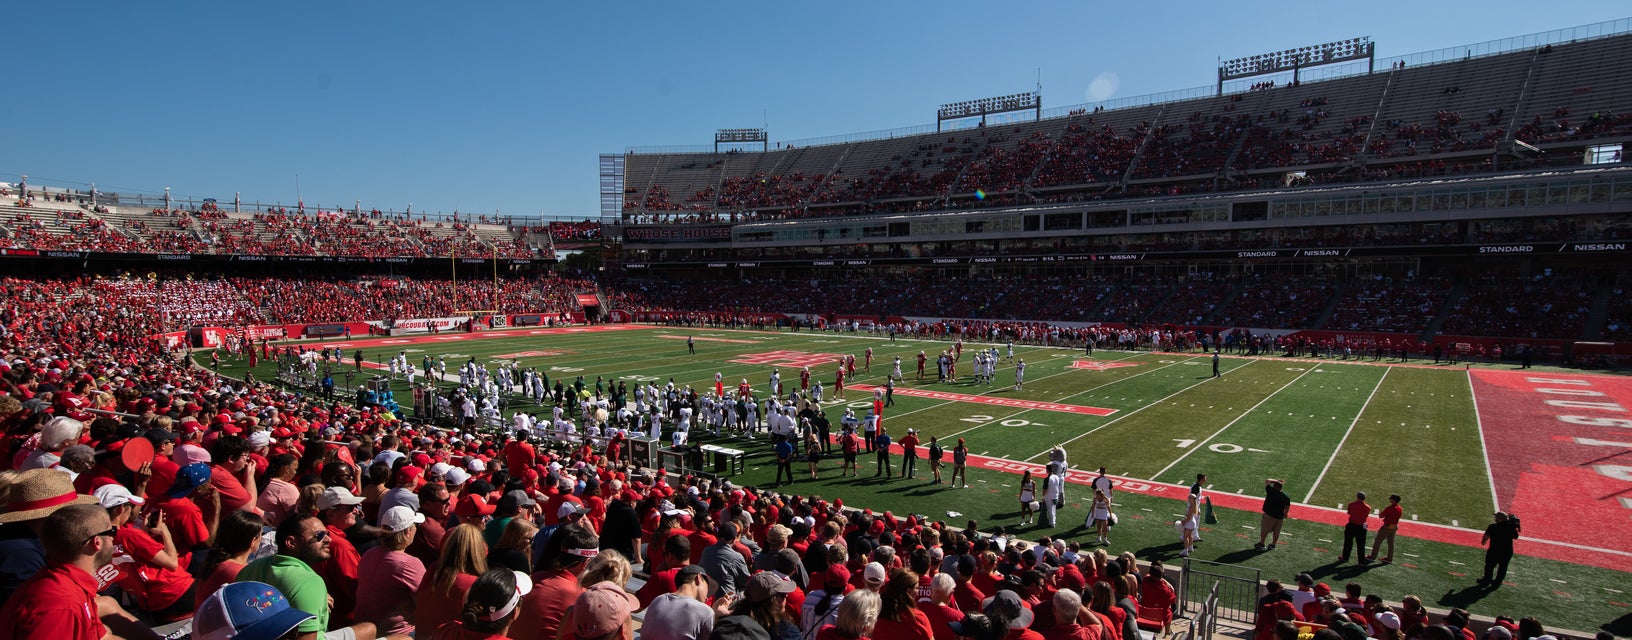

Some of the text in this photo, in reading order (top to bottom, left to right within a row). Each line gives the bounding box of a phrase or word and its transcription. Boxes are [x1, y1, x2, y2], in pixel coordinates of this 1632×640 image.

[627, 228, 731, 239] WHOSE HOUSE
[1479, 245, 1533, 253] STANDARD
[1574, 243, 1625, 251] NISSAN
[1172, 438, 1243, 453] 10
